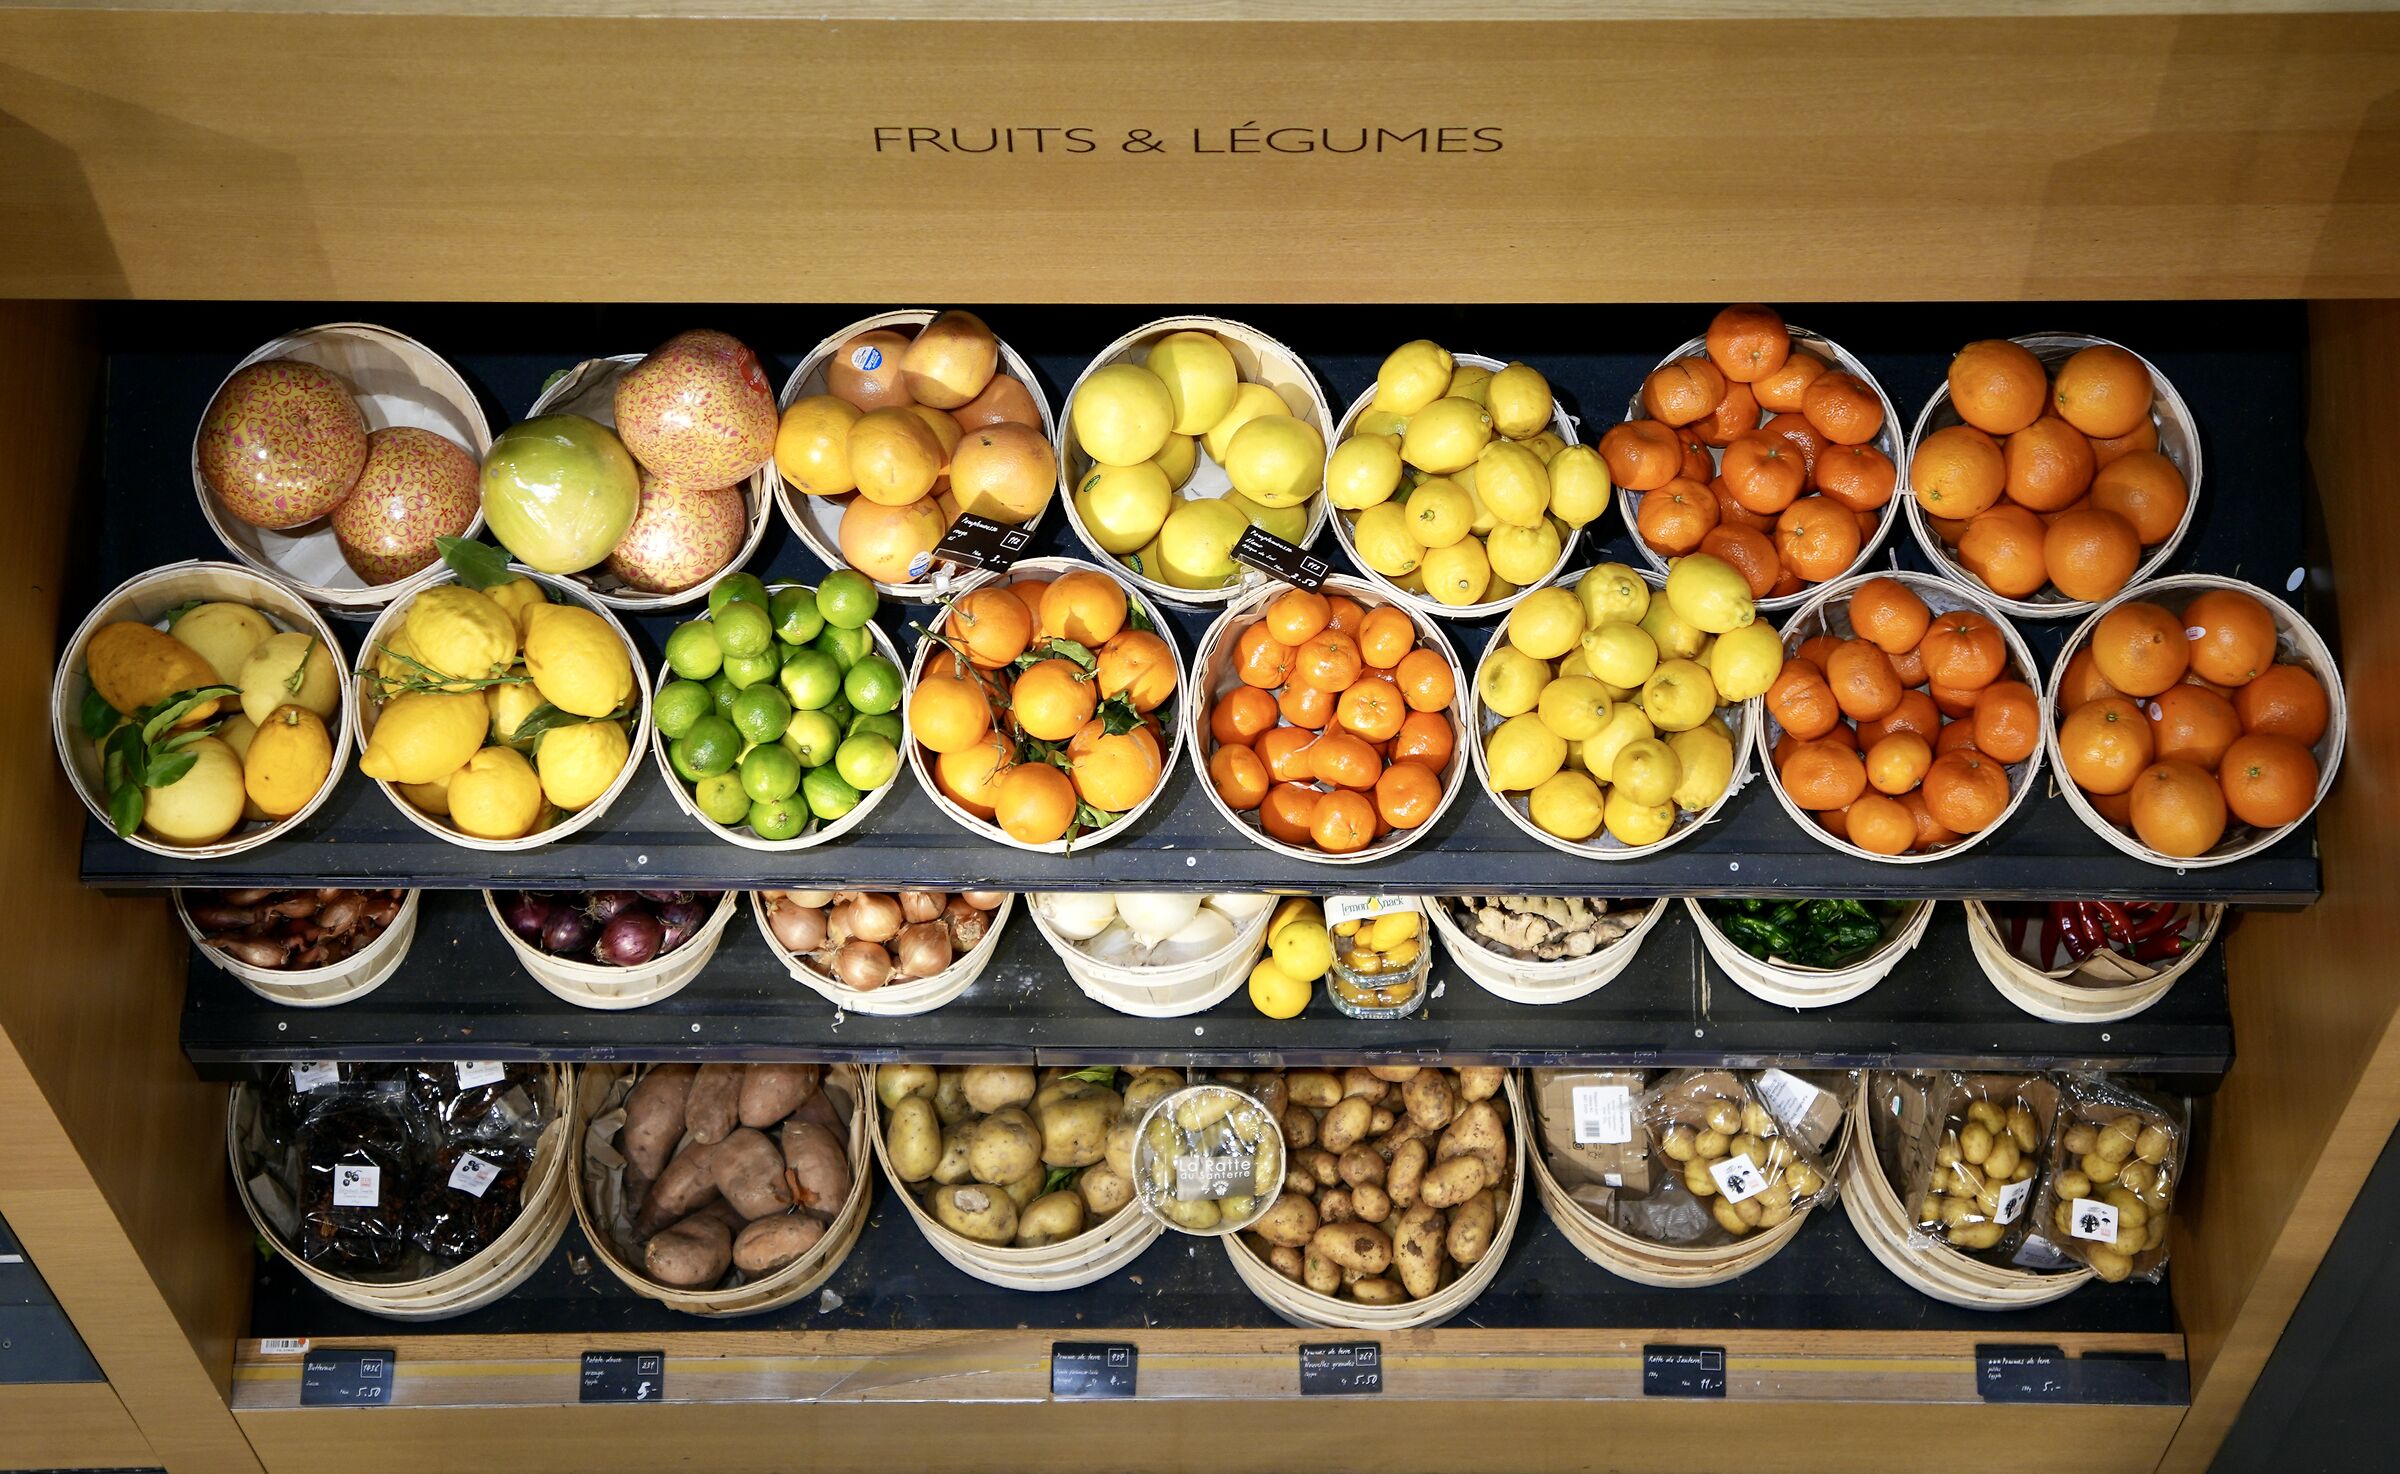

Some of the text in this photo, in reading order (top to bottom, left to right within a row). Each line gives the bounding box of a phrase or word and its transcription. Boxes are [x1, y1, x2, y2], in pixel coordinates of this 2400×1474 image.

[873, 120, 1505, 153] FRUITS & LÉGUMES
[1179, 1159, 1251, 1172] La Ratte
[1354, 1374, 1378, 1385] 5.50
